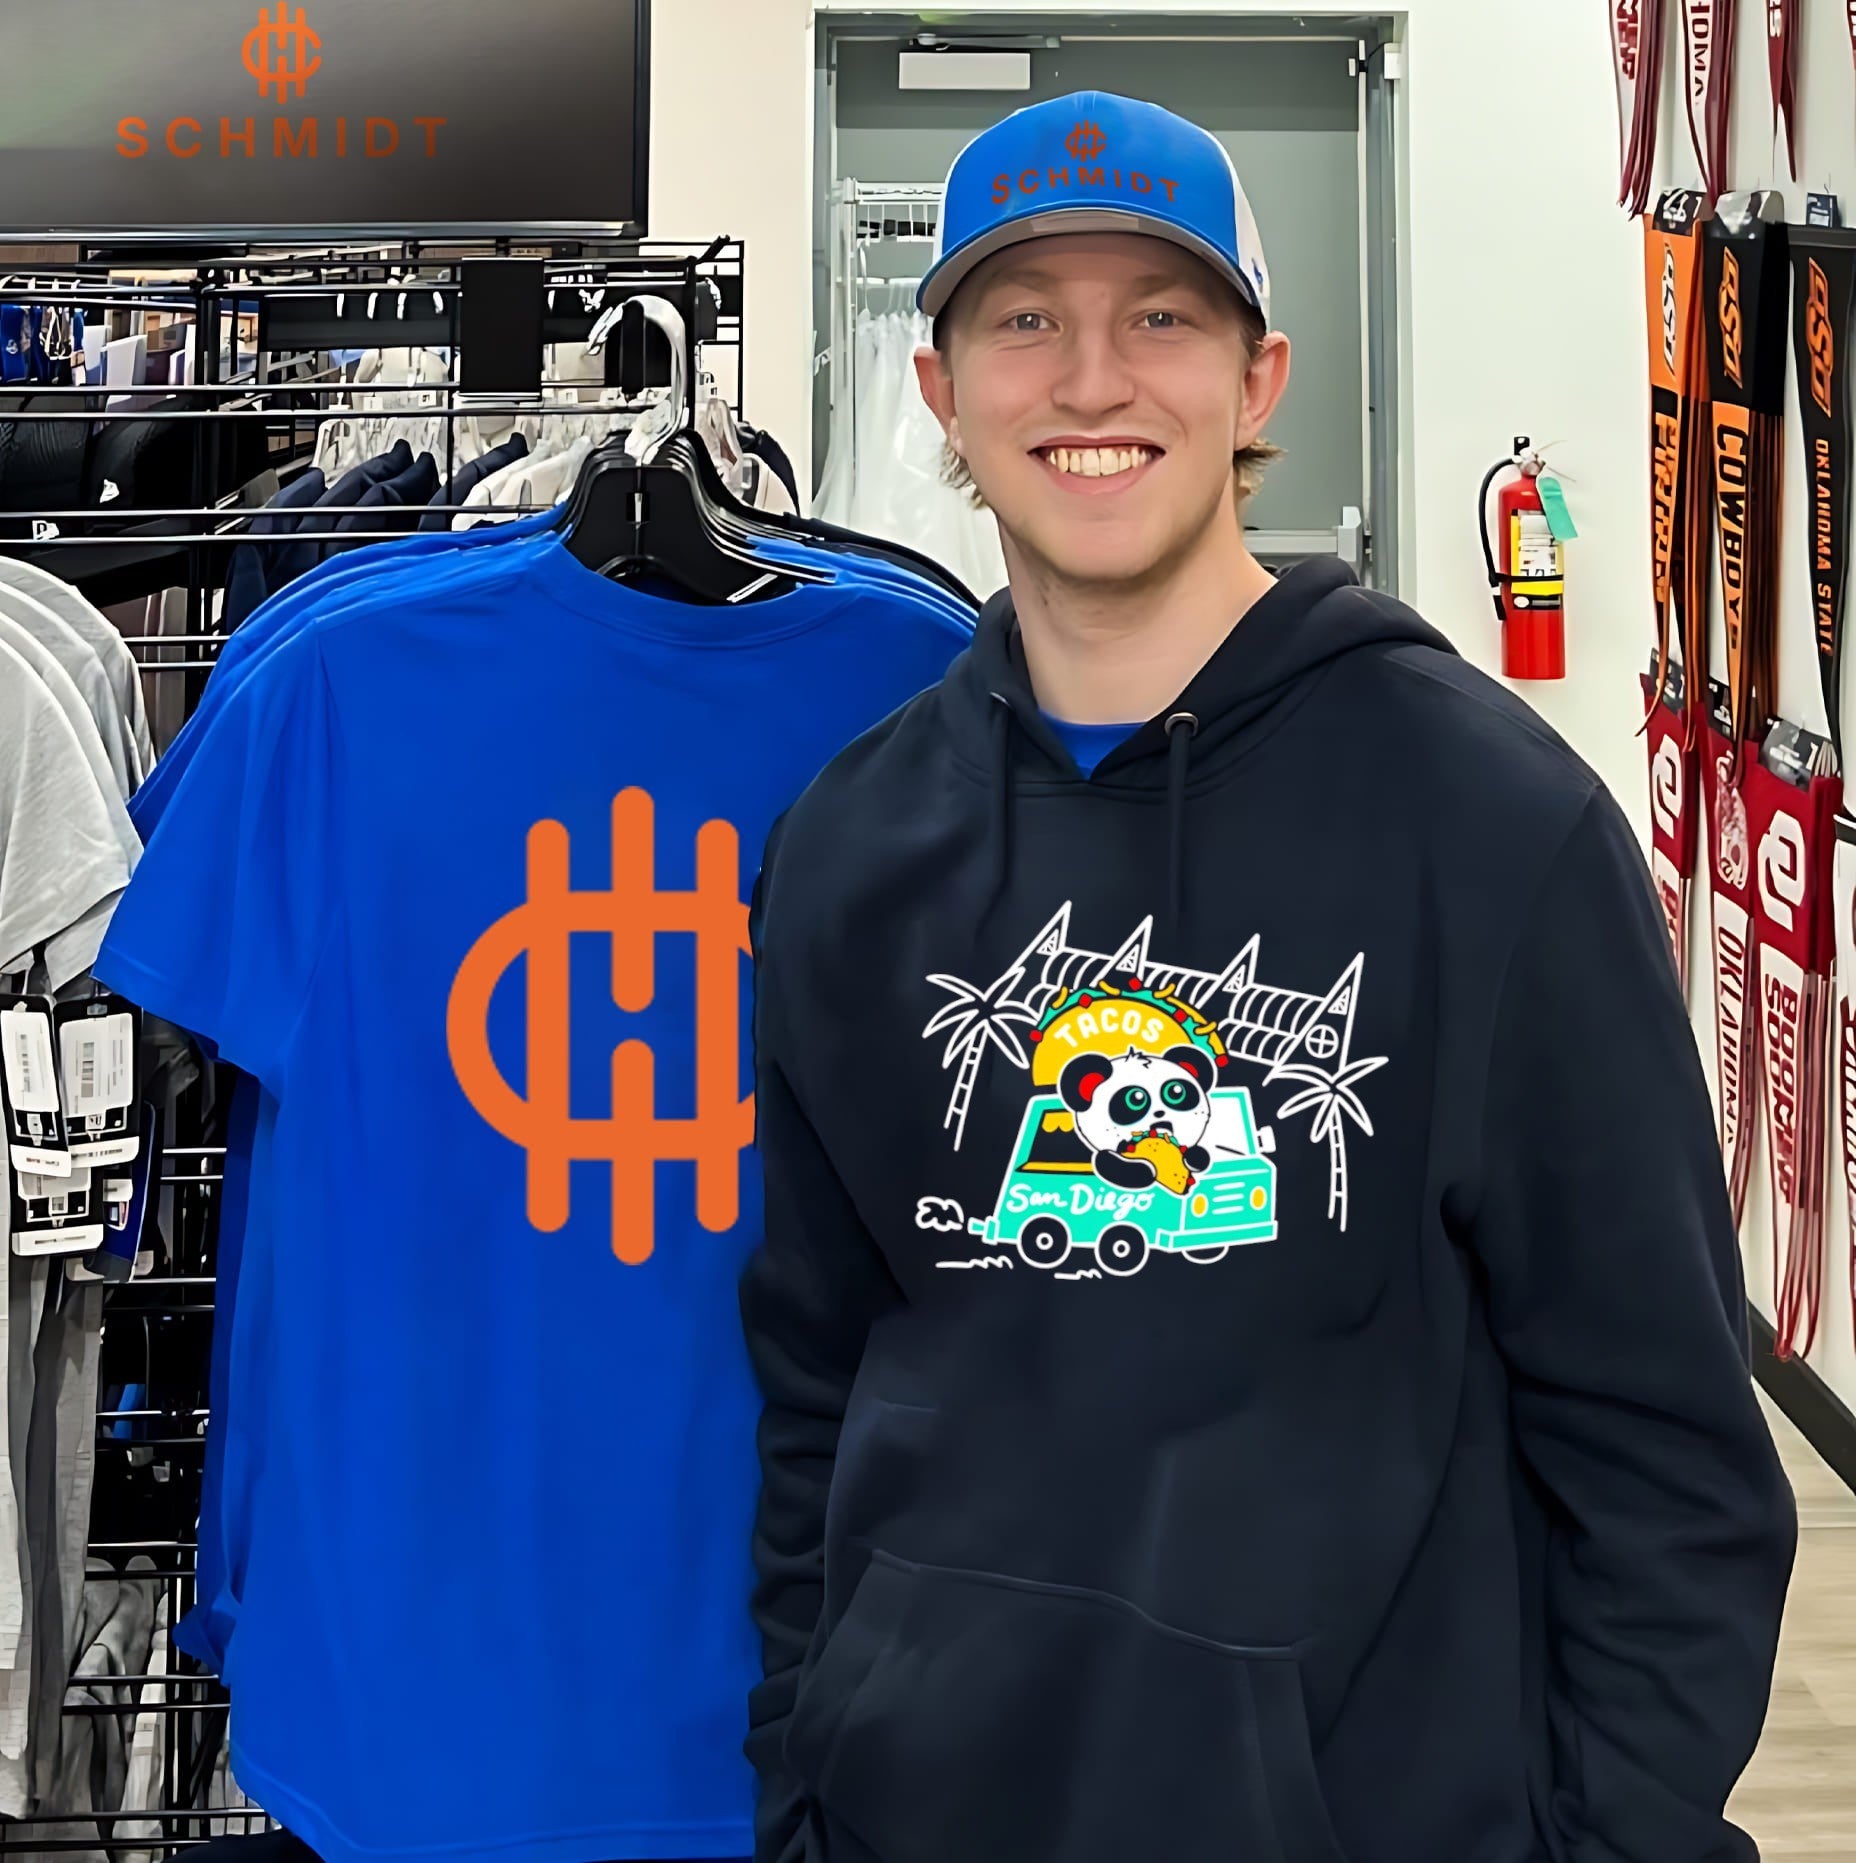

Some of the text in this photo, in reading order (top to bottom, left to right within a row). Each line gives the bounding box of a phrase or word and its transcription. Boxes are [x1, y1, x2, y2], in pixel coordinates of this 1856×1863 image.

[115, 115, 447, 159] SCHMIDT
[990, 166, 1180, 205] SCHMIDT
[1815, 438, 1832, 571] OKLAHOMA
[1054, 1007, 1164, 1047] TACOS
[1718, 926, 1745, 1144] OKLAHOMA
[1005, 1183, 1156, 1221] San Diego
